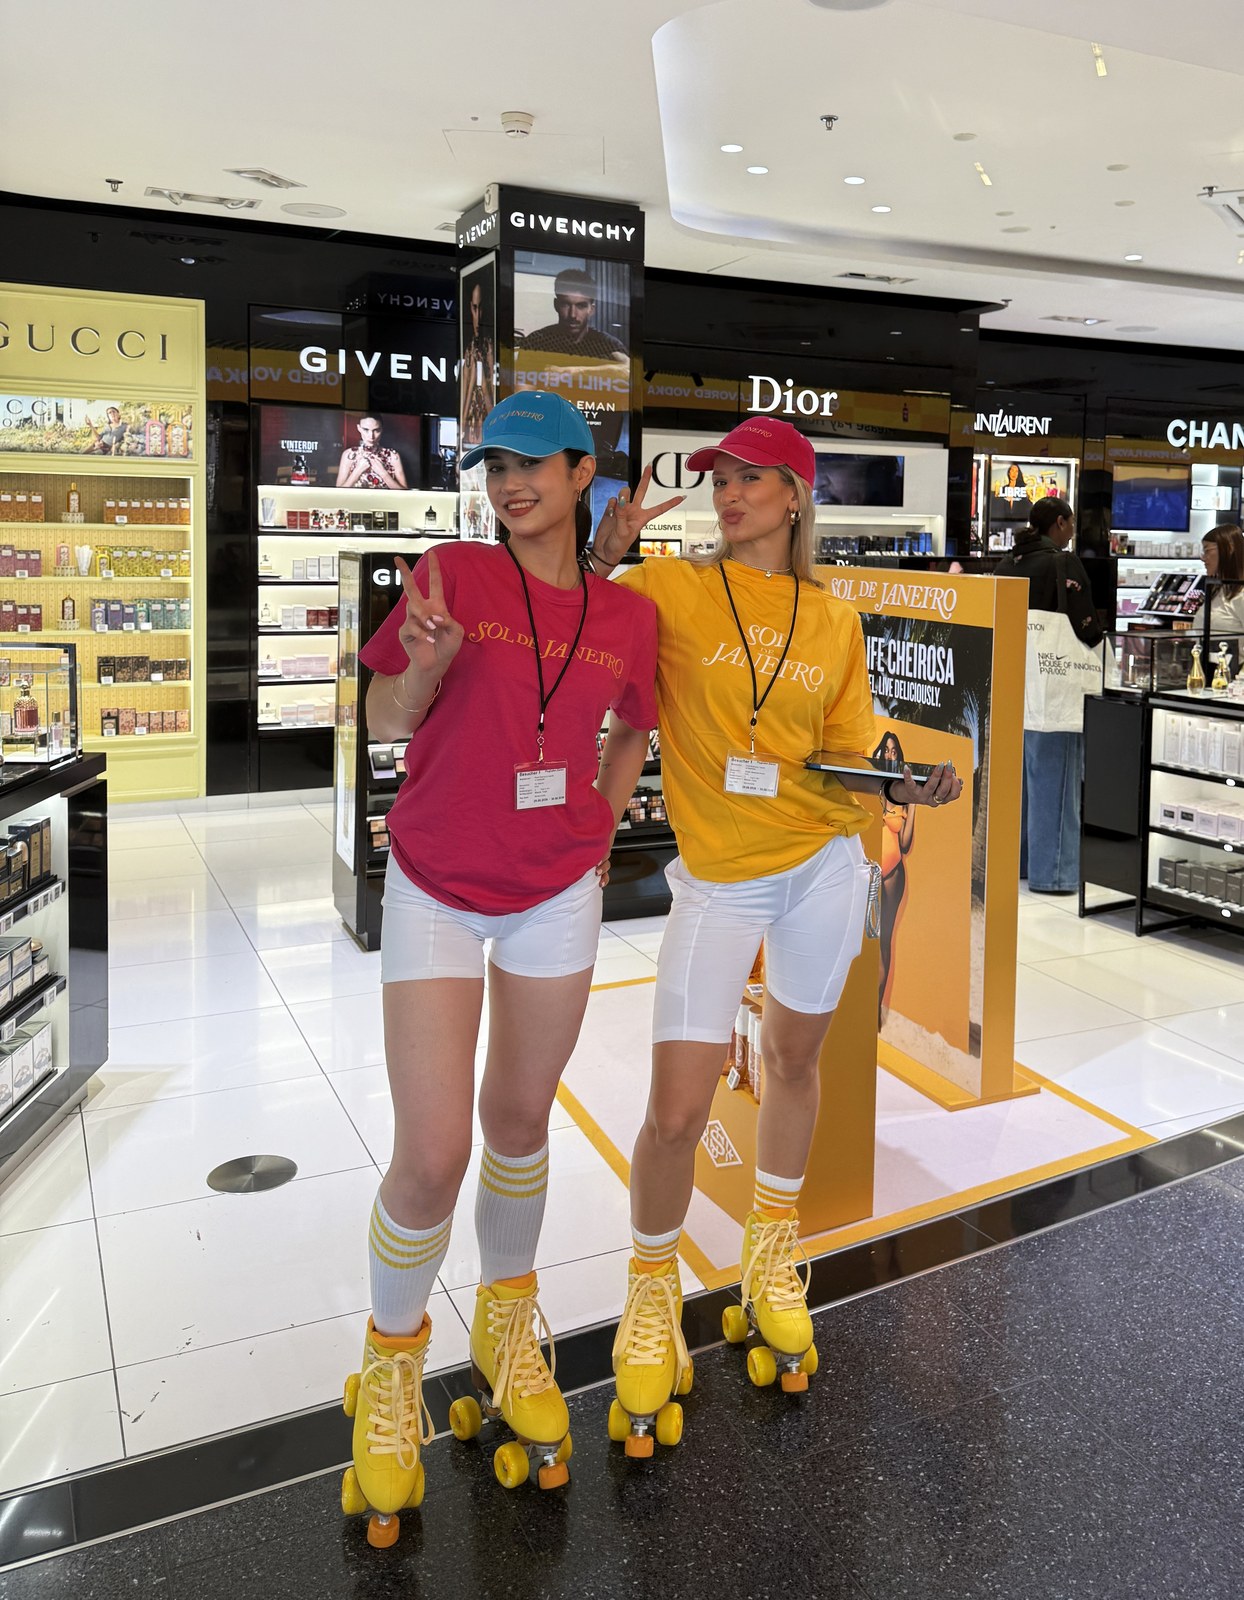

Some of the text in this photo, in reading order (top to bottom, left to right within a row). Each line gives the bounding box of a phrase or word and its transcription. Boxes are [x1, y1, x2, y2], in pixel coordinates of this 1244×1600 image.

[510, 211, 636, 242] GIVENCHY
[570, 400, 615, 412] EMAN
[747, 375, 838, 416] Dior
[1167, 419, 1244, 450] CHAN
[999, 486, 1027, 498] LIBRE
[858, 580, 878, 598] DE
[874, 582, 957, 620] JANEIRO
[468, 621, 514, 643] SOL
[540, 639, 624, 679] JANEIRO
[887, 639, 955, 686] CHEIROSA
[1038, 652, 1054, 660] NIKE
[1039, 660, 1062, 668] HOUSE
[1064, 660, 1073, 669] OF
[701, 642, 824, 693] JANEIRO
[878, 676, 894, 699] LIVE
[894, 678, 942, 708] DELICIOUSLY.
